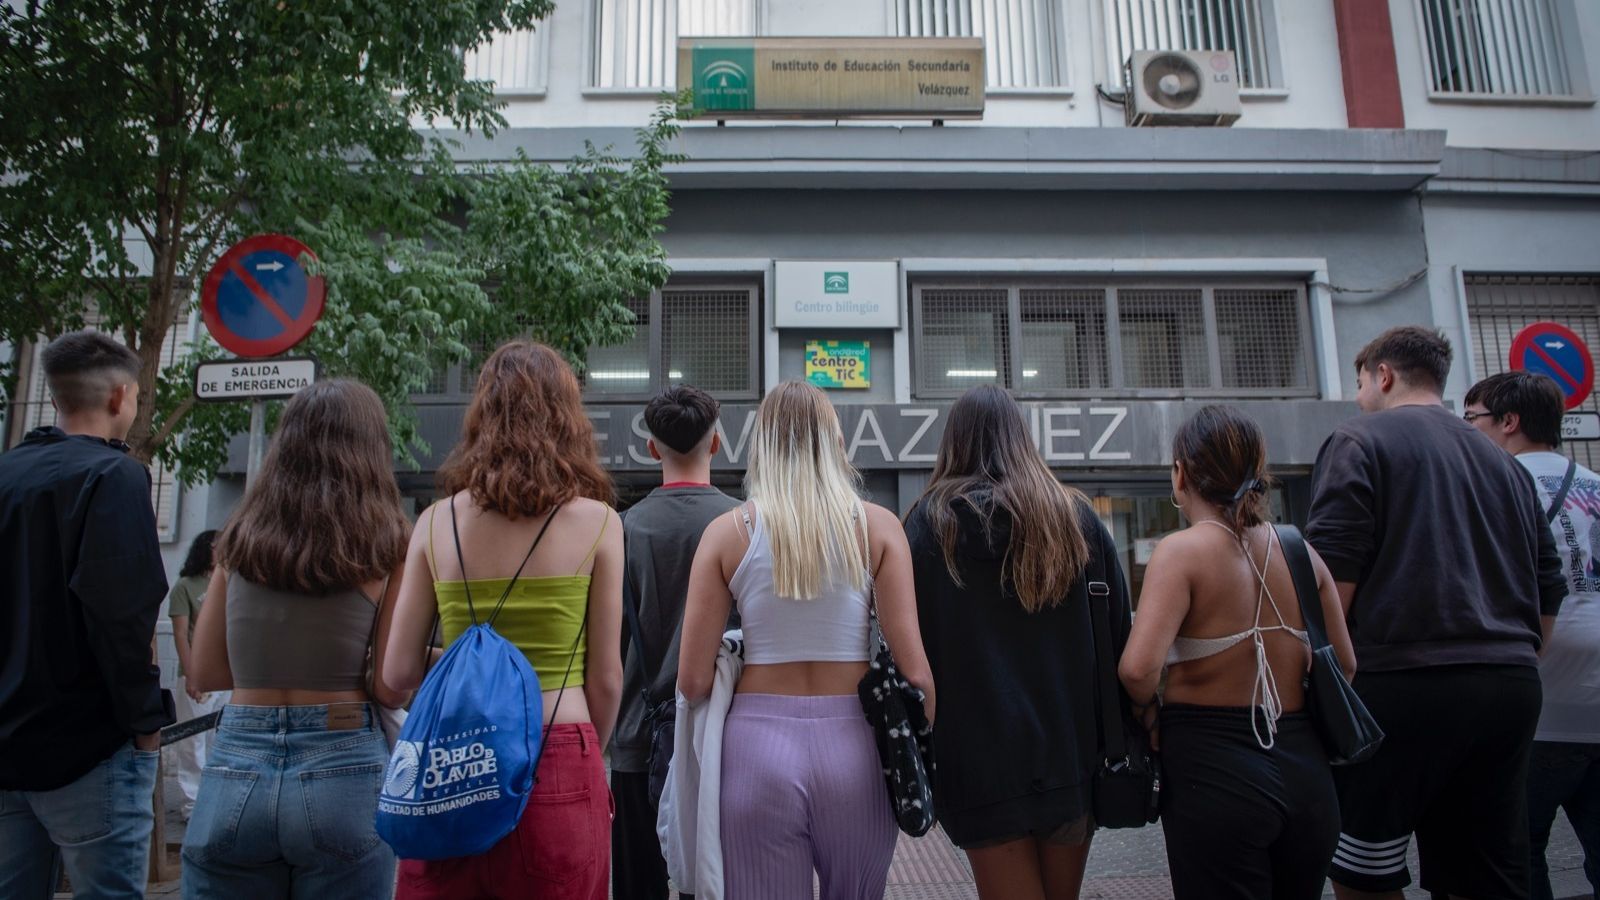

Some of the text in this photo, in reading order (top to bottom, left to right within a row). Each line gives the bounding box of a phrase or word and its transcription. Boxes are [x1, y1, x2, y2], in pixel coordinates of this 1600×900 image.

[771, 59, 970, 73] Instituto de Educación Secundaria
[1213, 74, 1230, 83] LG
[918, 82, 970, 97] Velázquez
[794, 300, 833, 313] Centro
[811, 355, 857, 367] centro
[231, 365, 280, 377] SALIDA
[201, 378, 309, 393] DE EMERGENCIA
[429, 743, 485, 769] PABLO
[422, 757, 498, 789] OLAVIDE
[420, 777, 498, 799] SEVILLA
[412, 805, 425, 816] DE
[427, 789, 501, 815] HUMANIDADES
